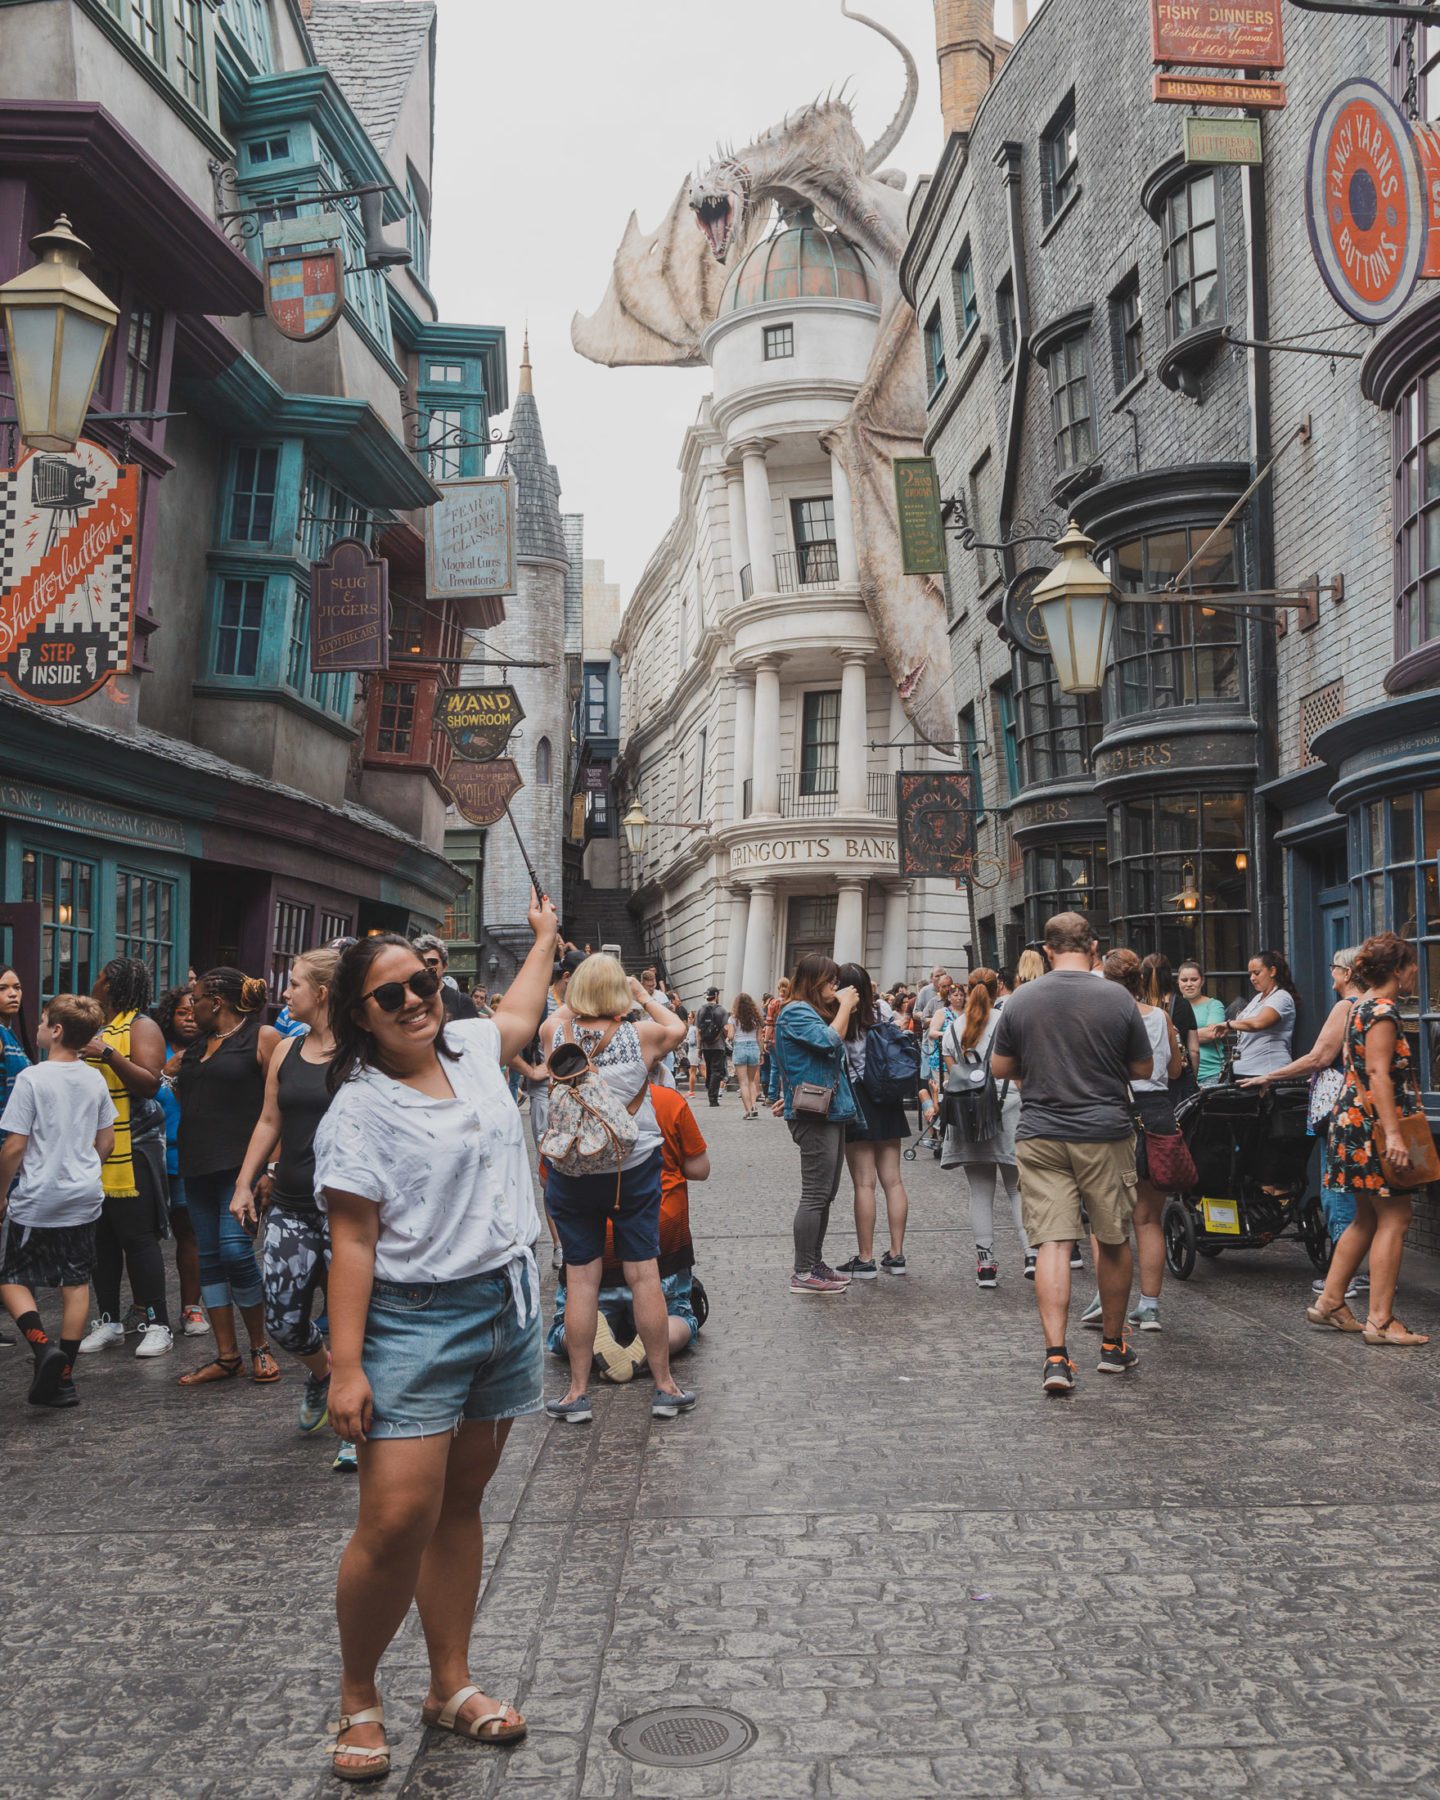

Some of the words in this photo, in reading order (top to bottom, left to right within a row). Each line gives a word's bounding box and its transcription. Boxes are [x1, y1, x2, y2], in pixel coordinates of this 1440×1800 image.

[1158, 5, 1200, 20] FISHY
[1209, 7, 1274, 25] DINNERS
[1167, 81, 1216, 97] BREWS
[1223, 85, 1272, 100] STEWS
[1331, 119, 1354, 198] FANCY
[1355, 114, 1399, 199] YARNS
[1339, 226, 1398, 289] BUTTONS
[451, 497, 482, 522] FEAR
[451, 508, 495, 539] FLYING
[441, 555, 475, 572] Magical
[477, 555, 501, 569] Cures
[330, 576, 367, 589] SLUG
[449, 573, 497, 587] Preventions
[319, 603, 378, 617] JIGGERS
[319, 625, 377, 653] APOTHECARY
[40, 643, 76, 662] STEP
[32, 664, 82, 685] INSIDE
[447, 693, 511, 712] WAND
[447, 713, 511, 728] SHOWROOM
[731, 838, 830, 867] GRINGOTTS
[845, 839, 896, 861] BANK
